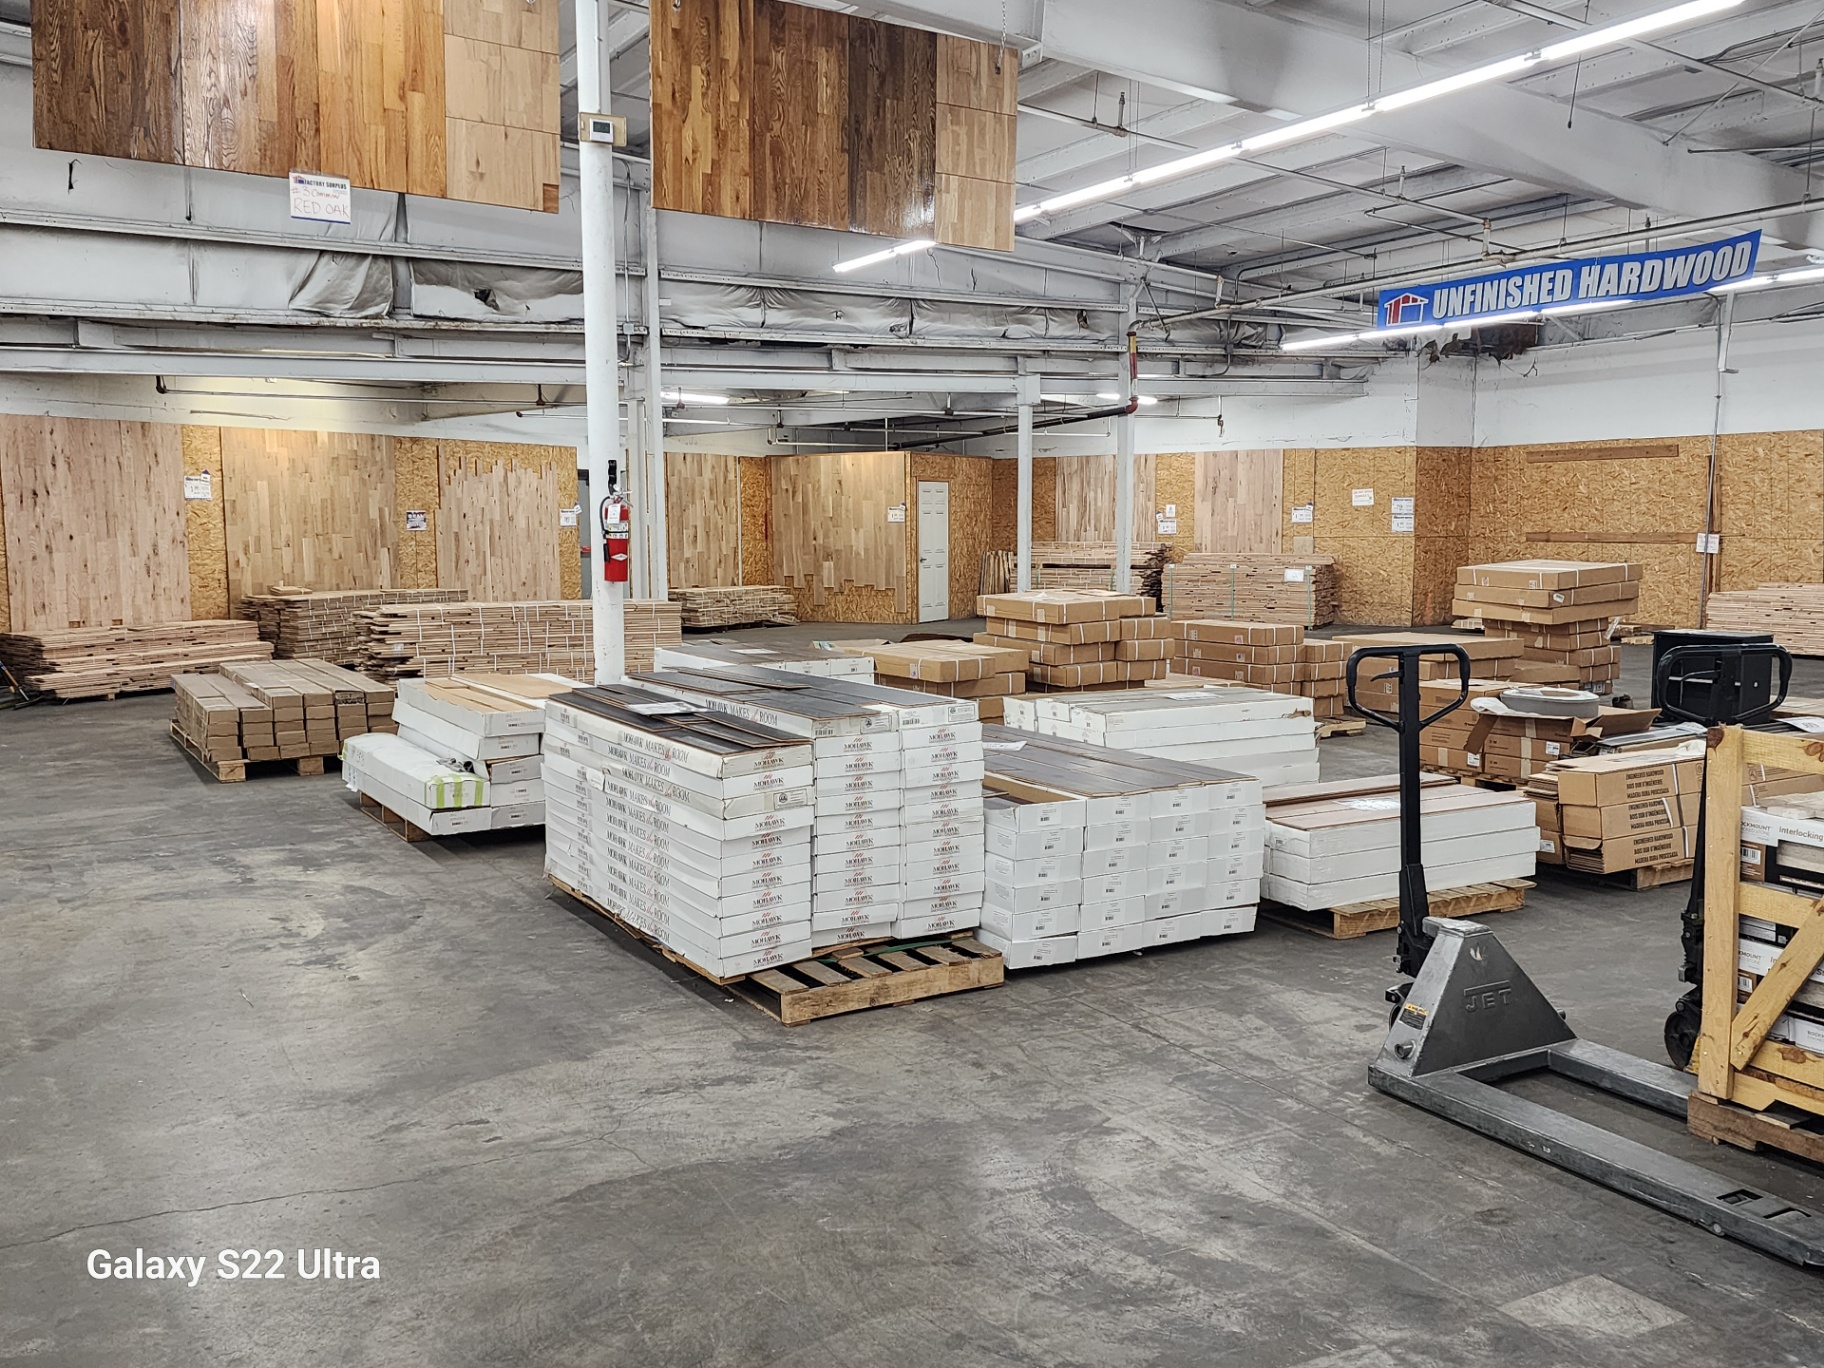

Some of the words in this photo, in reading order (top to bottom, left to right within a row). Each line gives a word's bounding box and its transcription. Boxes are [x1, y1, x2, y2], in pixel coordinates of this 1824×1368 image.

[304, 179, 325, 187] FACTORY
[293, 198, 321, 214] RED
[326, 203, 349, 217] OAK
[1432, 268, 1574, 320] UNFINISHED
[1579, 239, 1753, 299] HARDWOOD
[929, 732, 956, 741] MOHAWK
[844, 742, 872, 750] MOHAWK
[931, 751, 958, 760] MOHAWK
[754, 757, 784, 767] MOHAWK
[845, 761, 873, 770] MOHAWK
[932, 770, 959, 778] MOHAWK
[753, 777, 784, 787] MOHAWK
[845, 780, 873, 789] MOHAWK
[931, 788, 958, 797] MOHAWK
[845, 800, 873, 808] MOHAWK
[932, 807, 959, 816] MOHAWK
[755, 818, 785, 828] MOHAWK
[845, 818, 873, 827] MOHAWK
[933, 826, 959, 835] MOHAWK
[1779, 826, 1823, 842] Interlocking
[751, 836, 782, 846] MOHAWK
[846, 838, 874, 846] MOHAWK
[933, 845, 960, 854] MOHAWK
[752, 856, 782, 865] MOHAWK
[845, 856, 873, 864] MOHAWK
[933, 863, 960, 872] MOHAWK
[752, 876, 782, 885] MOHAWK
[844, 876, 872, 884] MOHAWK
[933, 882, 960, 891] MOHAWK
[752, 895, 782, 905] MOHAWK
[845, 894, 873, 902] MOHAWK
[931, 901, 957, 909] MOHAWK
[752, 915, 782, 925] MOHAWK
[841, 914, 869, 923] MOHAWK
[928, 920, 954, 929] MOHAWK
[751, 934, 781, 944] MOHAWK
[836, 931, 865, 940] MOHAWK
[753, 953, 783, 964] MOHAWK
[1465, 989, 1512, 1012] JET
